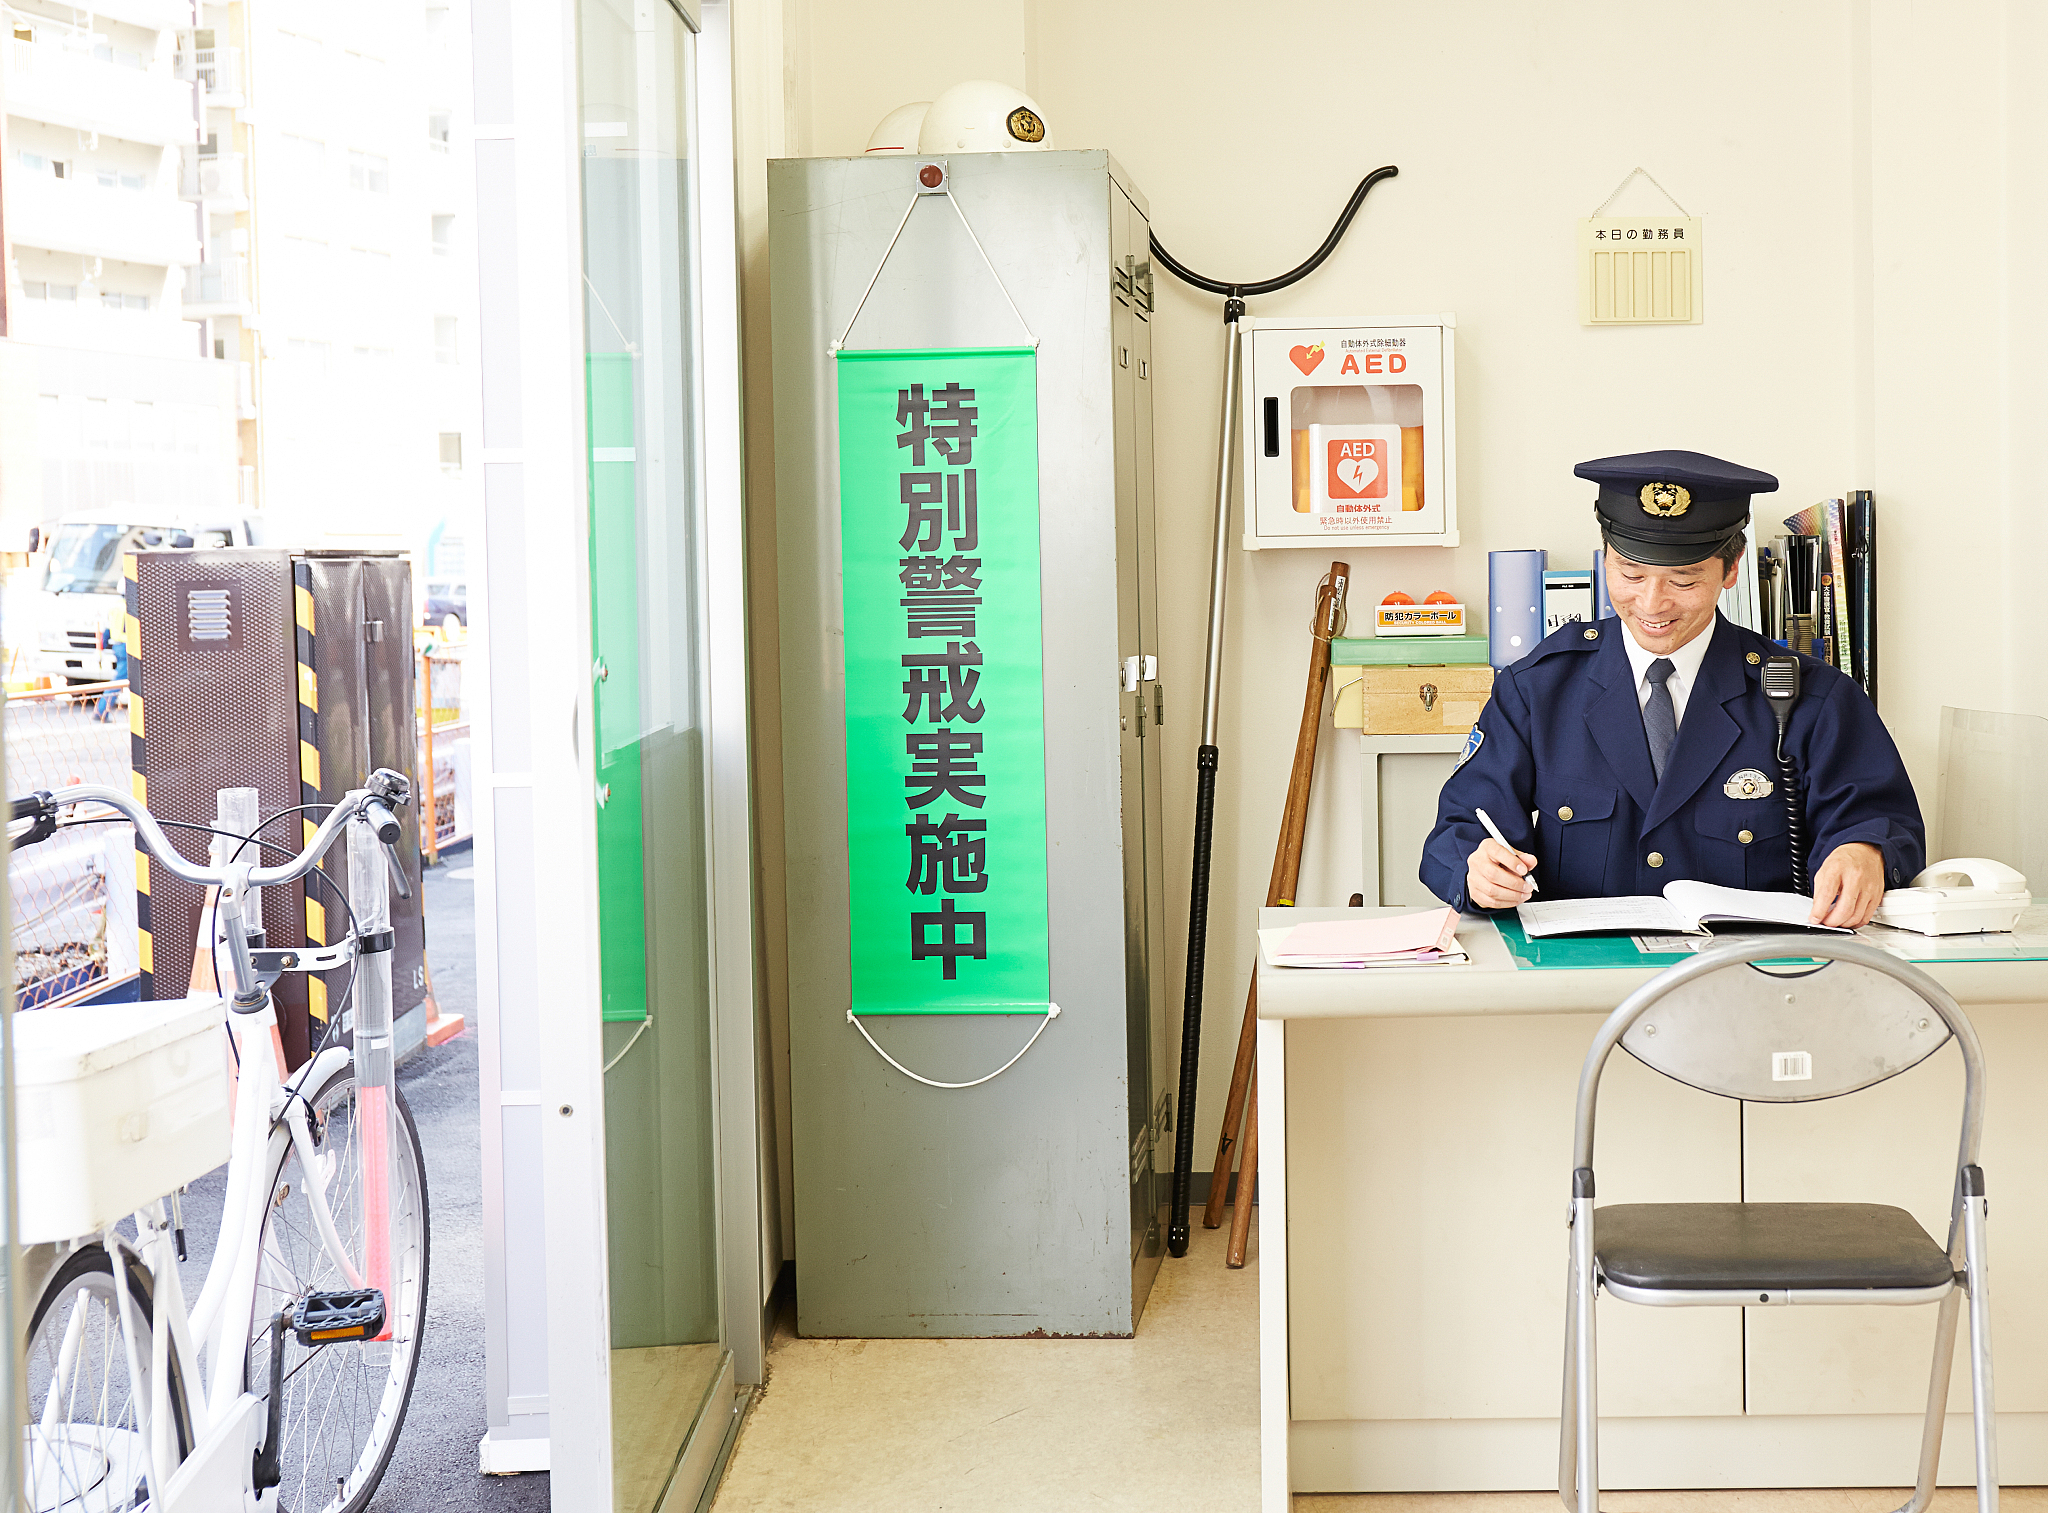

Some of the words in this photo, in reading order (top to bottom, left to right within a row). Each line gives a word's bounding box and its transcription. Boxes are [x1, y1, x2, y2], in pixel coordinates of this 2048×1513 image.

[1595, 228, 1685, 241] 本日の勤務員
[1341, 338, 1407, 348] 自動体外式除細動器
[1340, 354, 1407, 375] AED
[1340, 442, 1375, 457] AED
[1336, 504, 1381, 513] 自動体外式
[1320, 516, 1393, 526] 緊急時以外使用禁止
[1384, 611, 1457, 621] 防犯カラーボール
[896, 383, 989, 980] 特別警戒実施中
